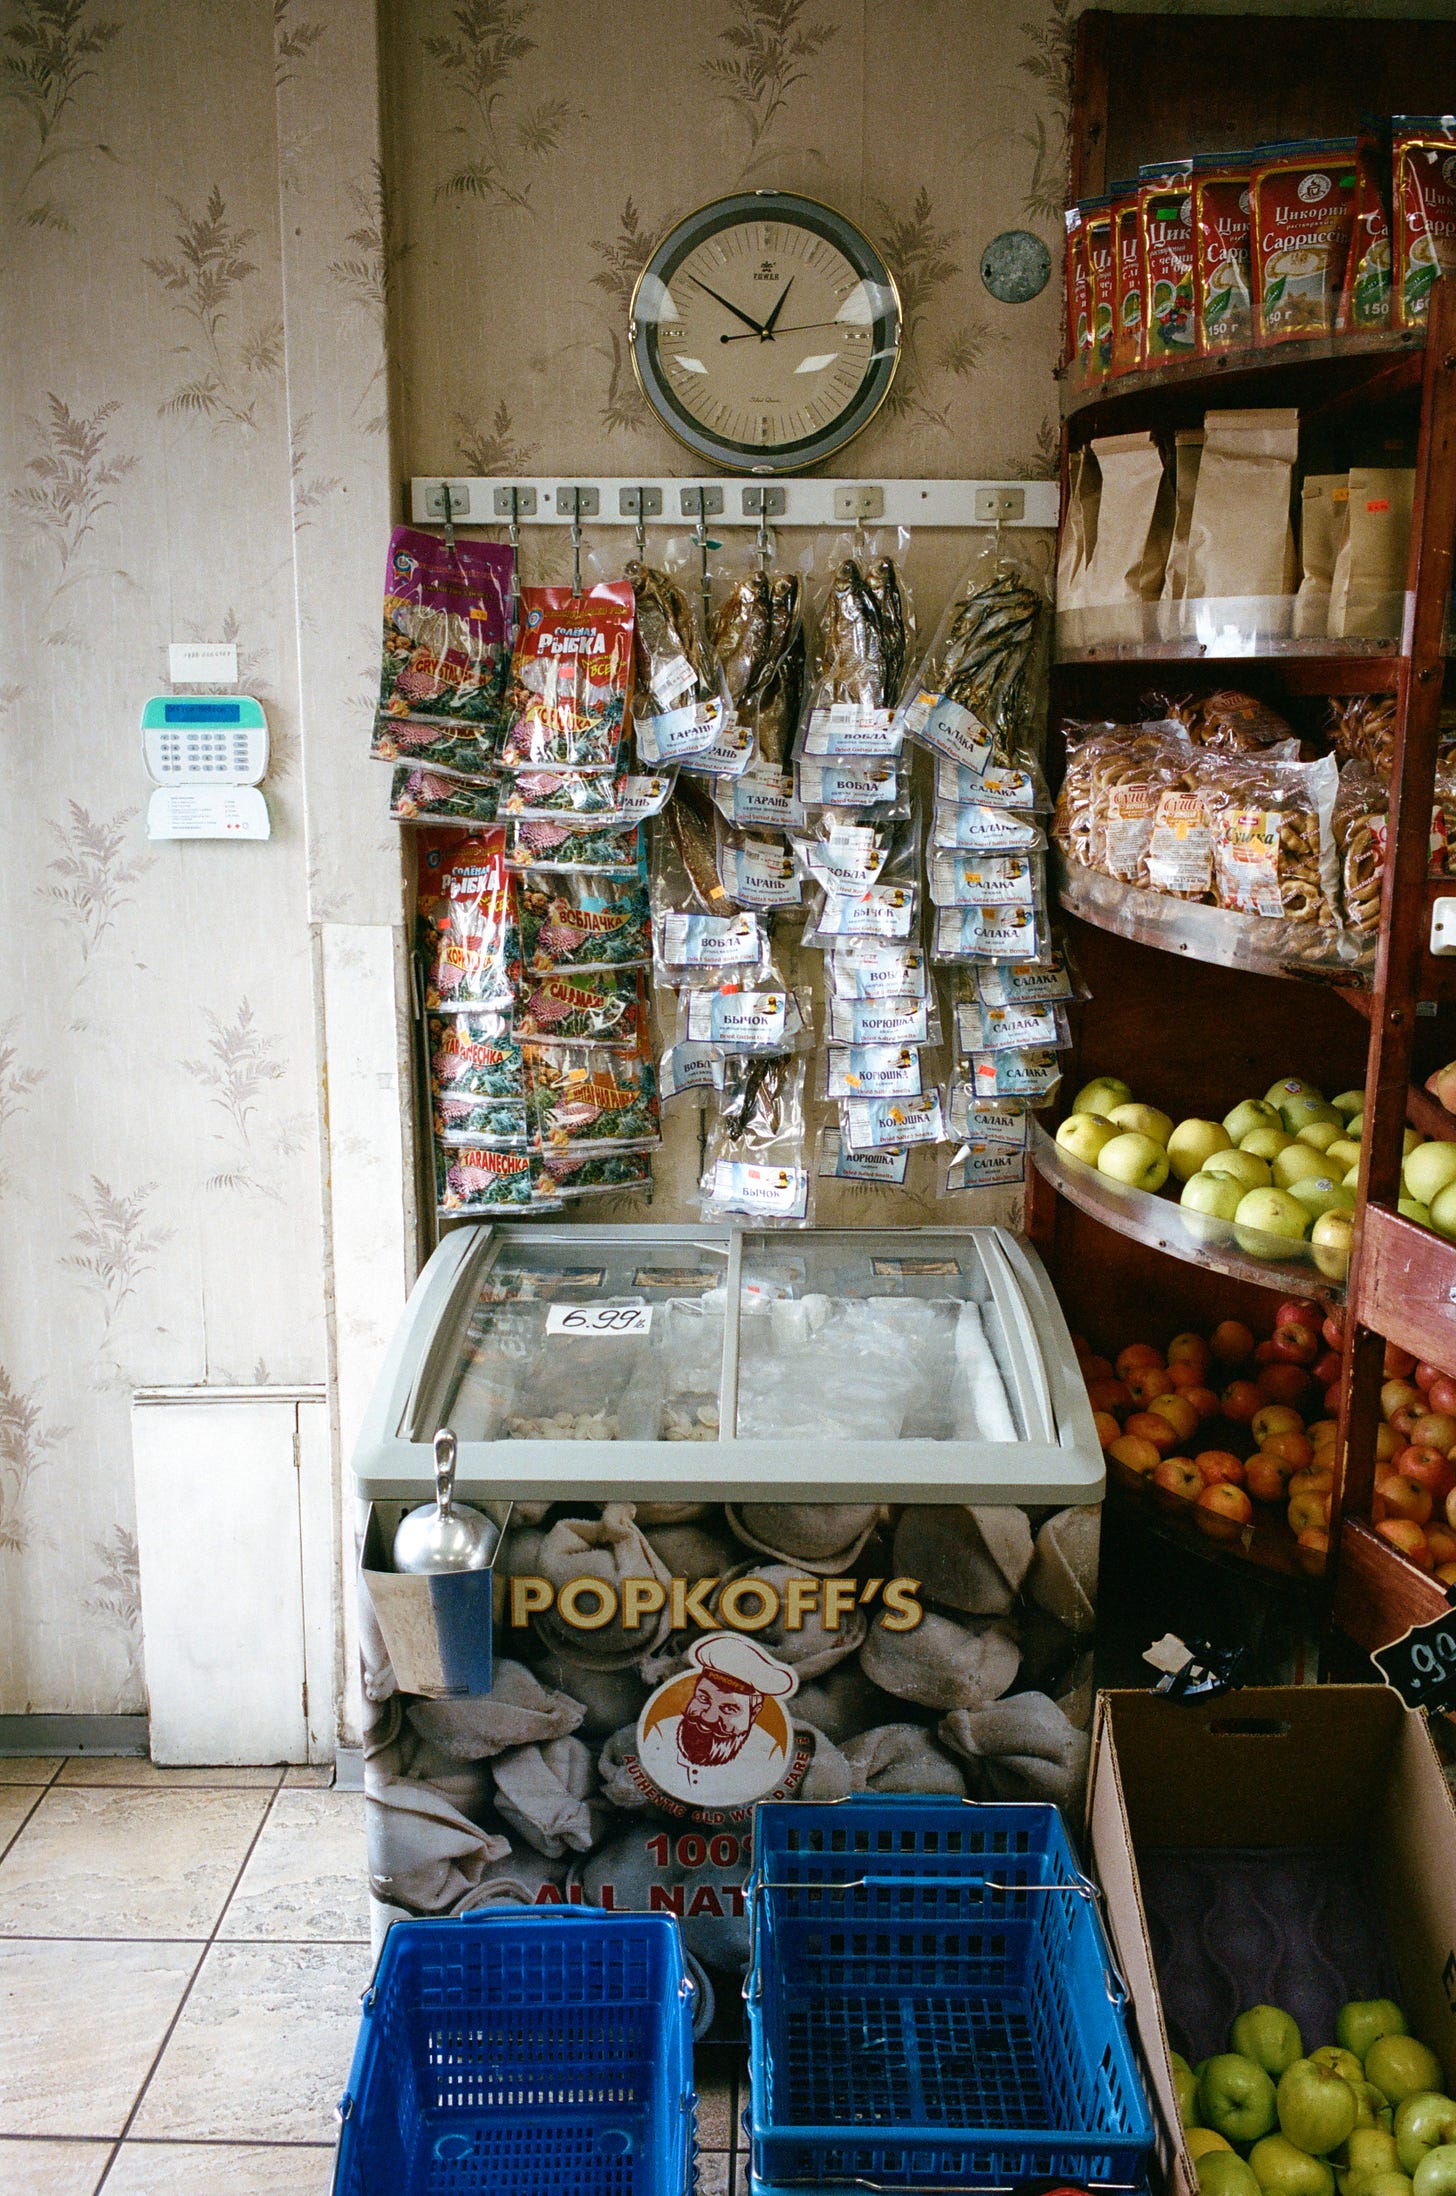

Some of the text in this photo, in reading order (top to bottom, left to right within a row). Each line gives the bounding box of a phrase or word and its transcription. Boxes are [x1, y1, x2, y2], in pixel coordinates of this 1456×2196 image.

[1275, 202, 1347, 225] Цикорий
[1363, 303, 1389, 315] 150
[1208, 322, 1227, 336] 150
[537, 632, 606, 656] РЫБКА
[669, 725, 714, 741] ТАРАНЬ
[938, 721, 975, 752] САЛАКА
[837, 780, 879, 791] ВОБЛА
[969, 783, 1017, 797] САЛАКА
[746, 795, 789, 807] ТАРАНЬ
[745, 876, 786, 888] ТАРАНЬ
[967, 880, 1015, 889] САЛАКА
[559, 909, 623, 931] ВОБЛАЧКА
[973, 927, 1020, 938] САЛАКА
[701, 937, 741, 947] ВОБЛА
[1013, 974, 1058, 987] САЛАКА
[724, 1015, 769, 1025] БЫЧОК
[861, 1016, 915, 1029] КОРЮШКА
[993, 1018, 1040, 1033] САЛАКА
[1006, 1069, 1048, 1078] САЛАКА
[974, 1115, 1014, 1127] САЛАКА
[464, 1152, 528, 1175] TARANECHKA
[846, 1153, 894, 1166] КОРЮШКА
[974, 1157, 1012, 1168] САЛАКА
[742, 1187, 780, 1198] БЫЧОК
[562, 1308, 641, 1330] 6.99
[511, 1576, 923, 1632] POPKOFF'S
[623, 1754, 687, 1818] AUTHENTIC
[692, 1811, 725, 1825] OLD
[784, 1751, 809, 1789] FARE
